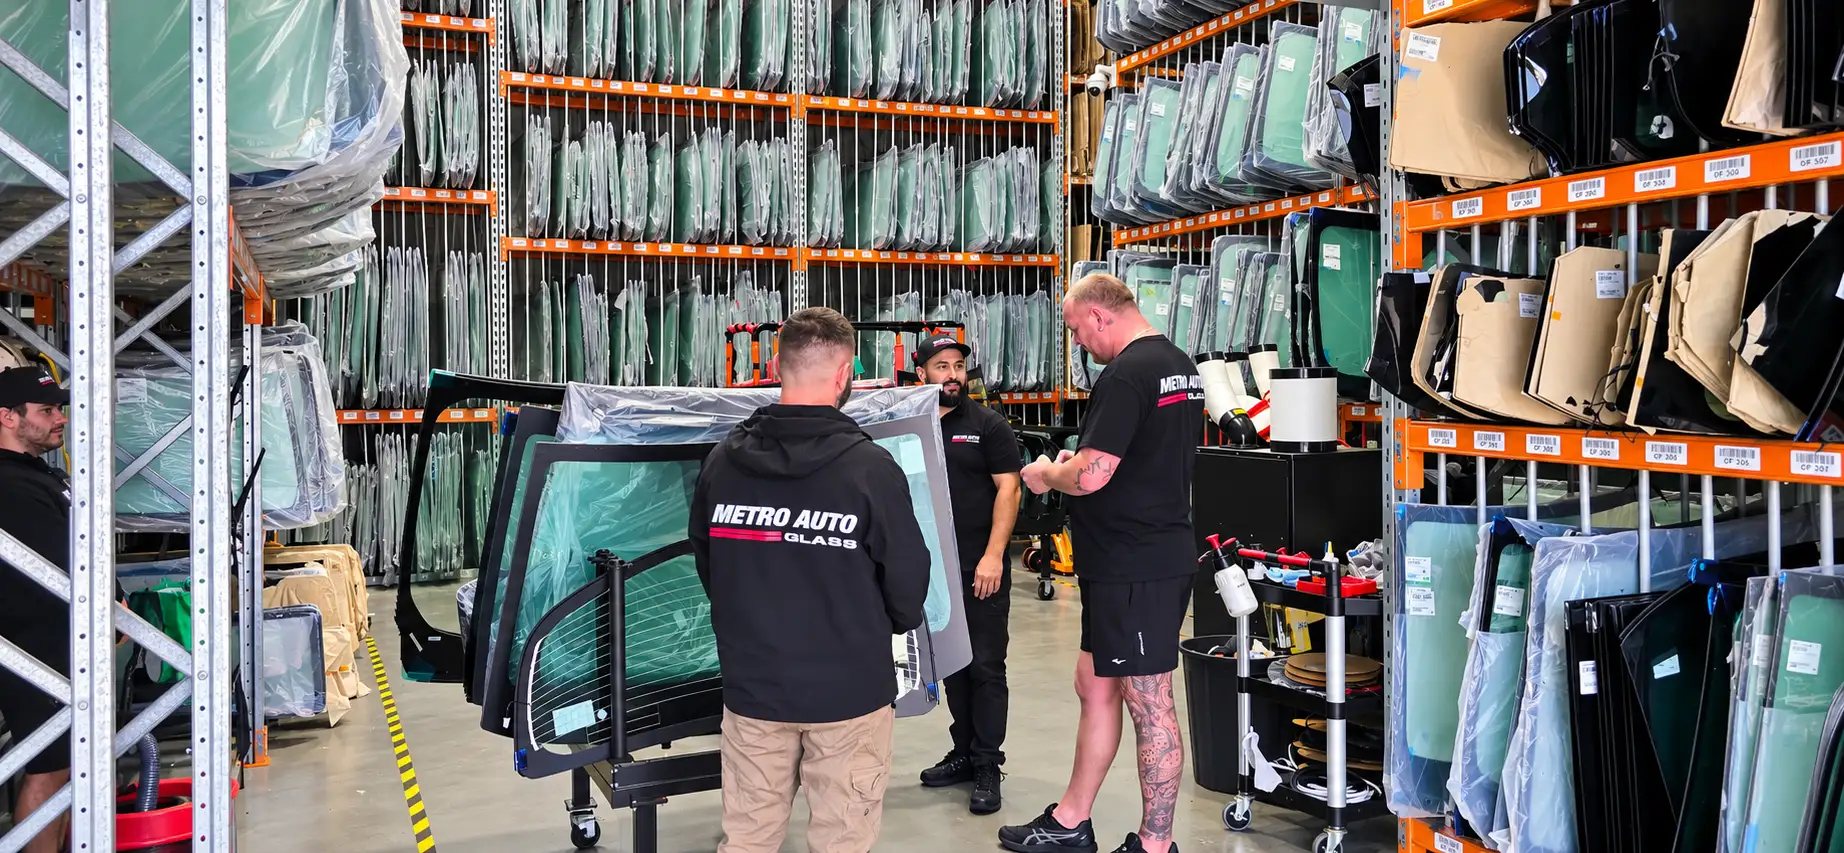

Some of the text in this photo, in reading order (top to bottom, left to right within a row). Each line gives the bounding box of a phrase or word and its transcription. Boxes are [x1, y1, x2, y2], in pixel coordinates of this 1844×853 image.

[1159, 375, 1188, 394] METRO
[711, 503, 858, 534] METRO AUTO
[784, 532, 858, 550] GLASS
